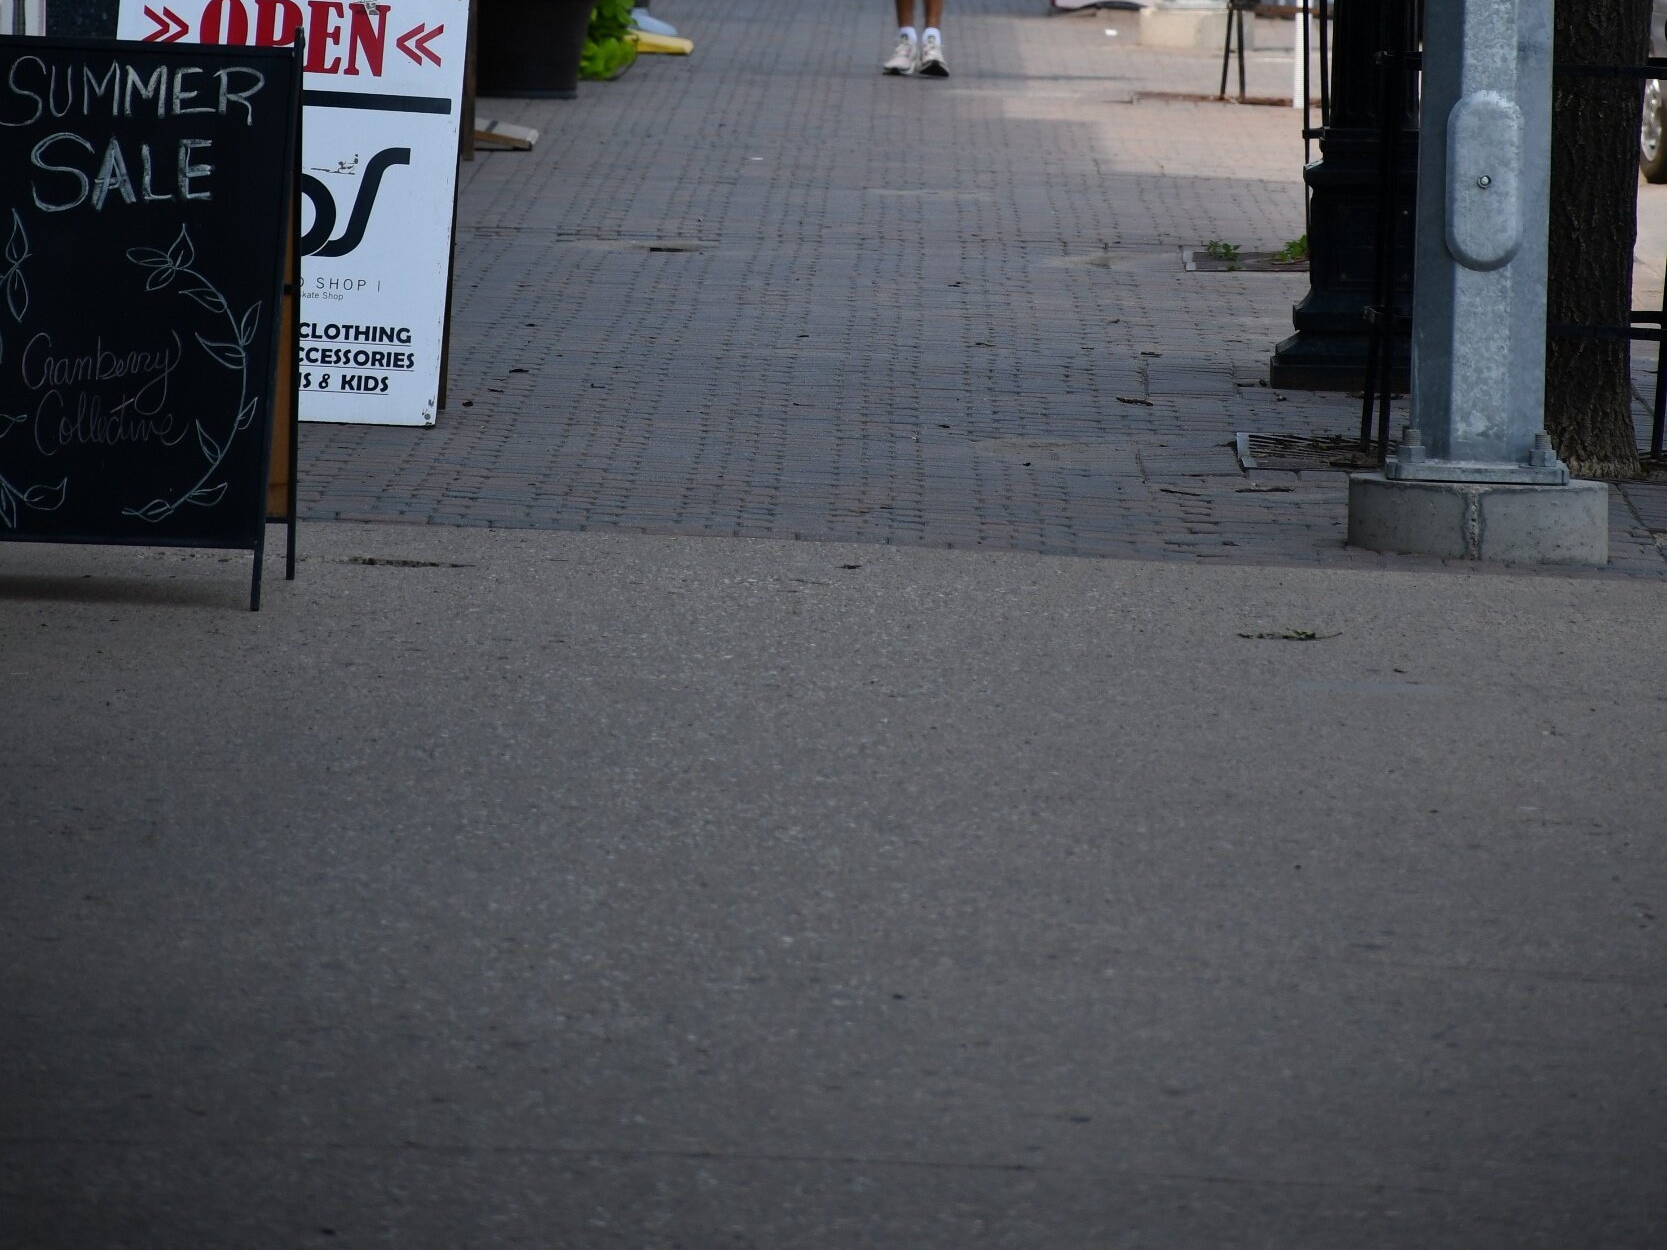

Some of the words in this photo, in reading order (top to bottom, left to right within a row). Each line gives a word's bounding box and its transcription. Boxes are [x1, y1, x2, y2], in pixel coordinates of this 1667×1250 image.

[0, 55, 265, 127] SUMMER
[31, 132, 216, 212] SALE
[301, 291, 320, 299] kate
[322, 291, 344, 301] Shop
[316, 277, 367, 291] SHOP
[300, 322, 411, 344] CLOTHING
[22, 330, 182, 415] Cranberry
[340, 374, 389, 392] KIDS
[35, 389, 190, 456] Collective
